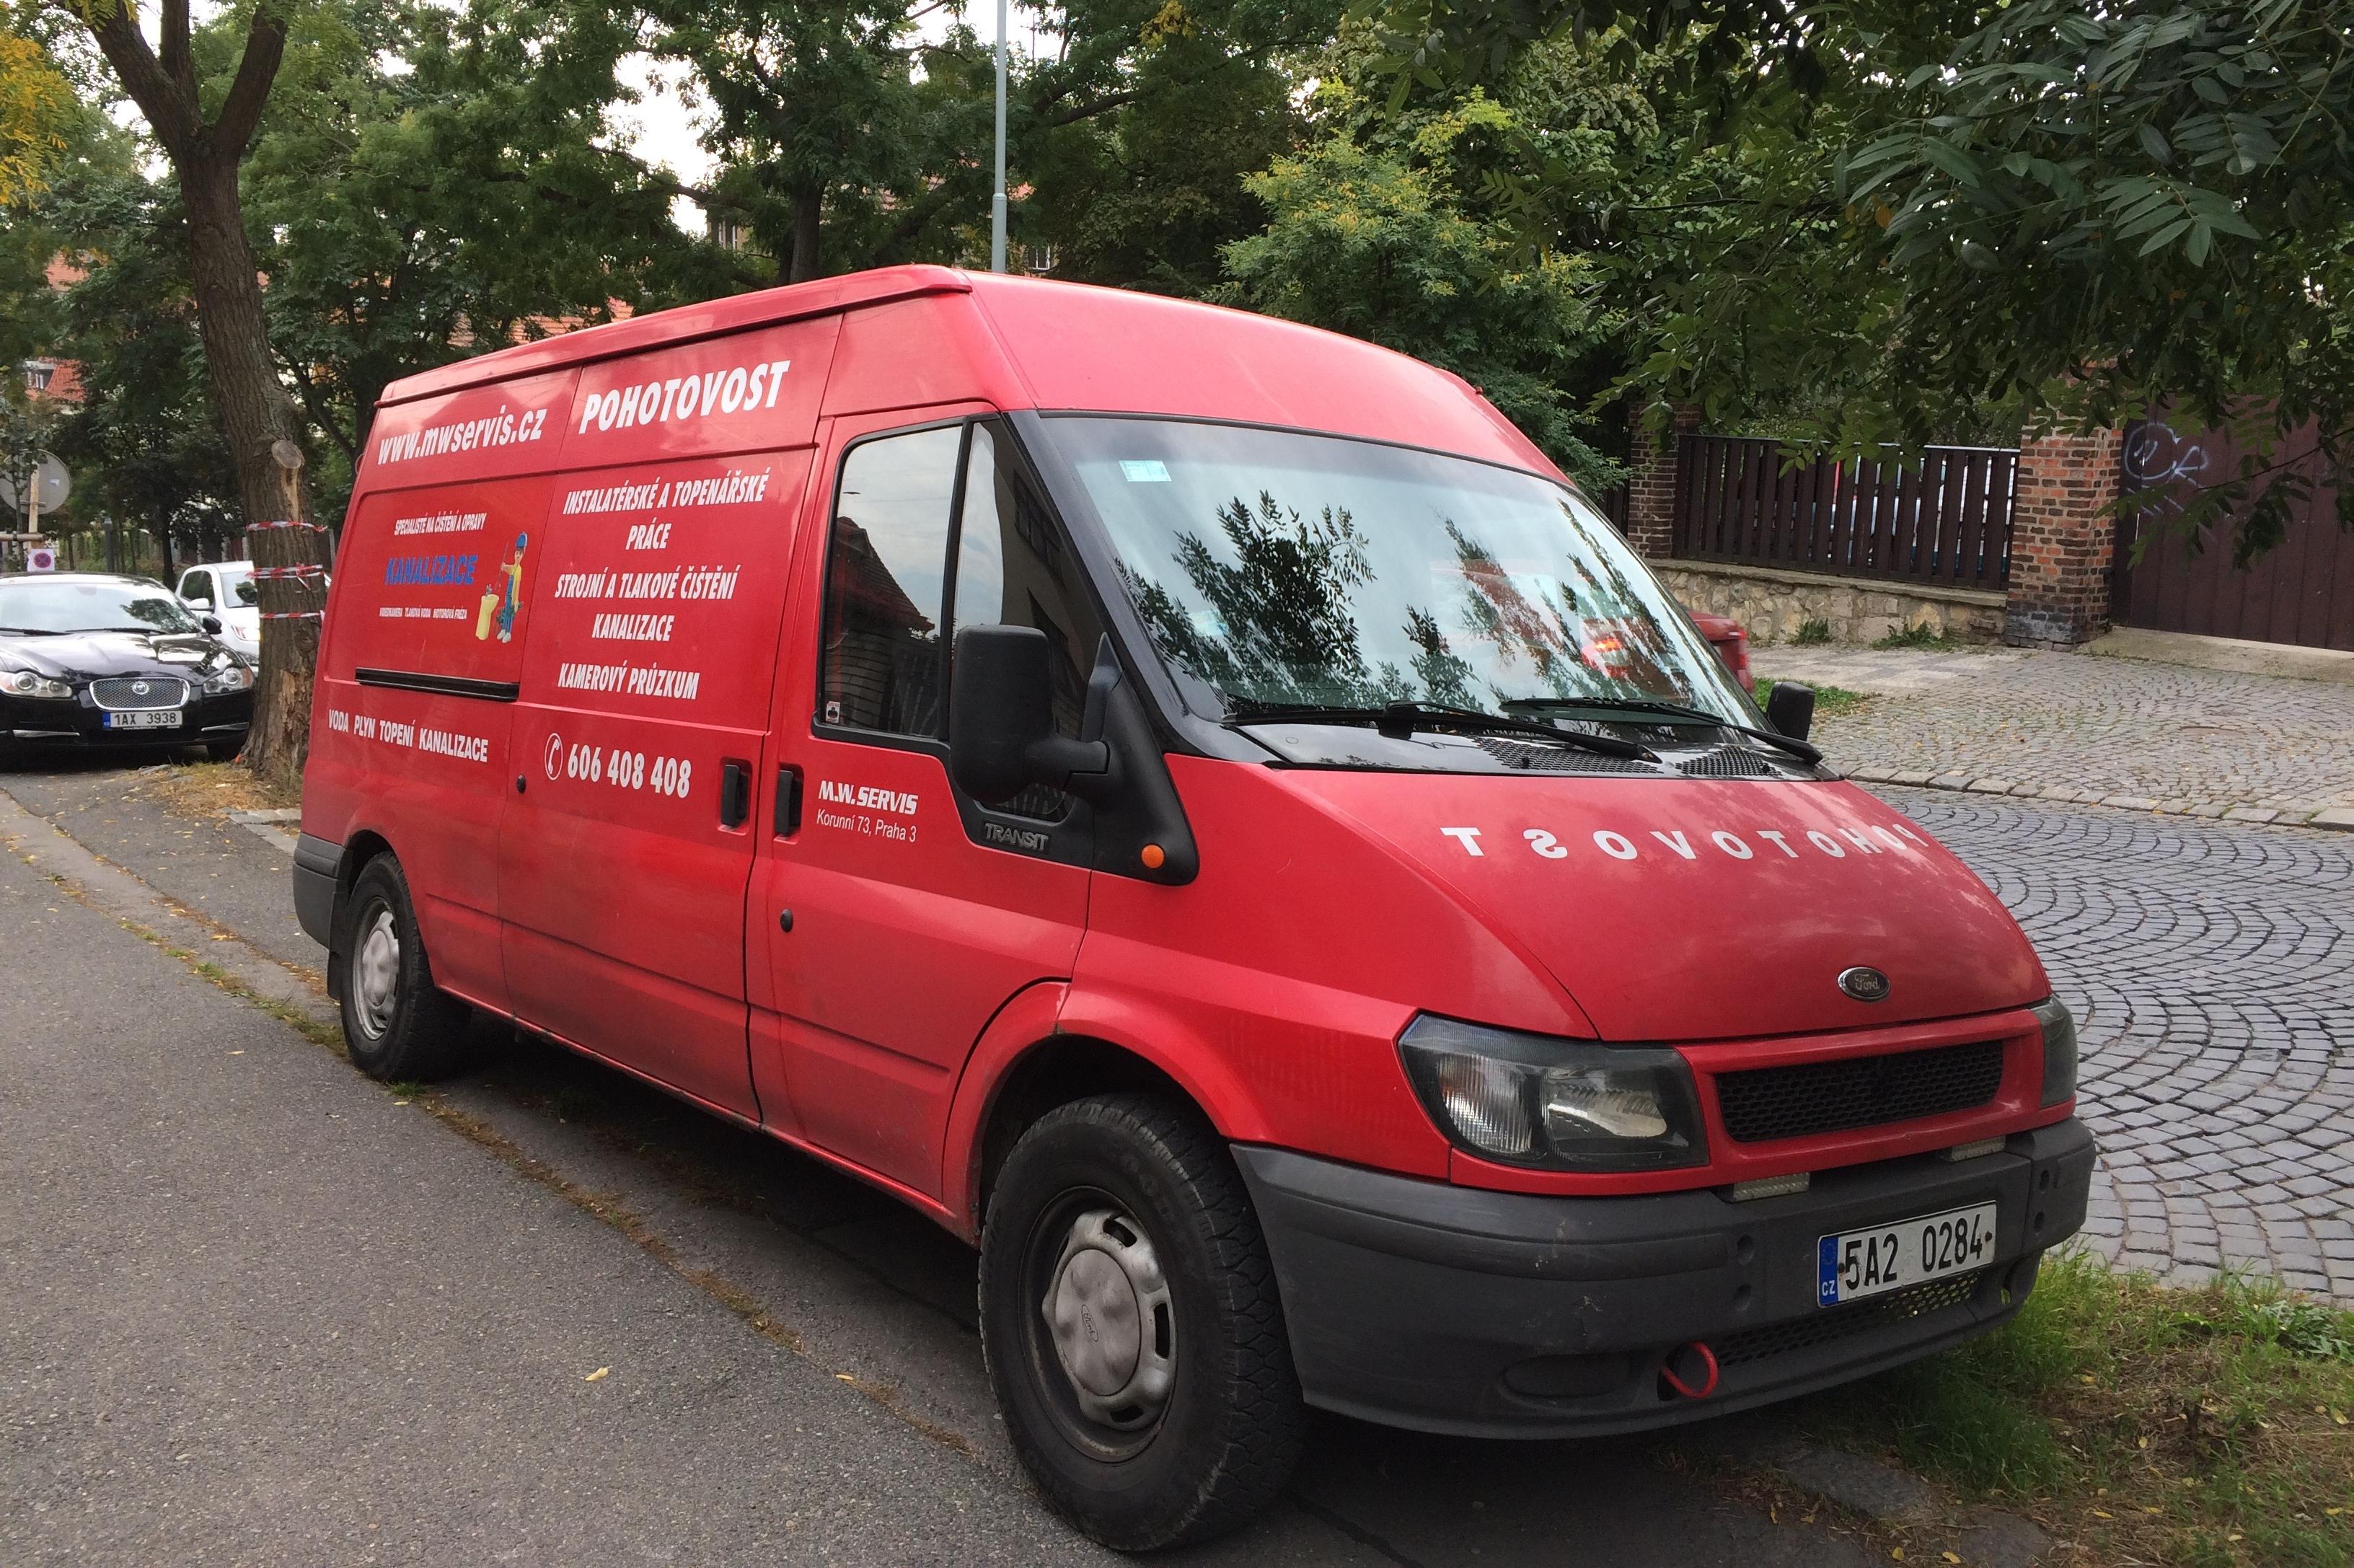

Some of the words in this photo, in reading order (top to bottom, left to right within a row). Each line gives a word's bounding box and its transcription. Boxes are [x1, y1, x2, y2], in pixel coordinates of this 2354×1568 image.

[578, 360, 790, 434] POHOTOVOST
[377, 405, 547, 465] www.mwservis.cz
[563, 477, 661, 515] INSTALATÉRSKÉ
[657, 483, 671, 508] A
[671, 467, 771, 507] TOPENÁŘSKÉ
[625, 517, 672, 550] PRÁCE
[384, 554, 479, 585] KANALIZACE
[554, 567, 609, 599] STROJNÍ
[604, 573, 617, 598] A
[618, 565, 681, 599] TLAKOVÉ
[680, 565, 741, 599] ČIŠTĚNÍ
[591, 614, 675, 641] KANALIZACE
[557, 660, 627, 692] KAMEROVÝ
[627, 662, 700, 700] PRŮZKUM
[114, 713, 137, 726] 1AX
[146, 713, 177, 724] 3938
[329, 709, 349, 732] VODA
[353, 715, 376, 739] PLYN
[379, 720, 416, 747] TOPENÍ
[418, 728, 489, 762] KANALIZACE
[568, 744, 601, 783] 606
[607, 749, 645, 790] 408
[651, 756, 692, 798] 408
[816, 808, 856, 831] Korunní
[857, 816, 872, 837] 73,
[875, 819, 907, 842] Praha
[909, 825, 917, 842] 3
[984, 822, 1049, 852] TRANSIT
[1854, 974, 1881, 991] Ford
[1845, 1233, 1899, 1290] 5A2
[1922, 1214, 1983, 1273] 0284
[1822, 1279, 1835, 1297] CZ
